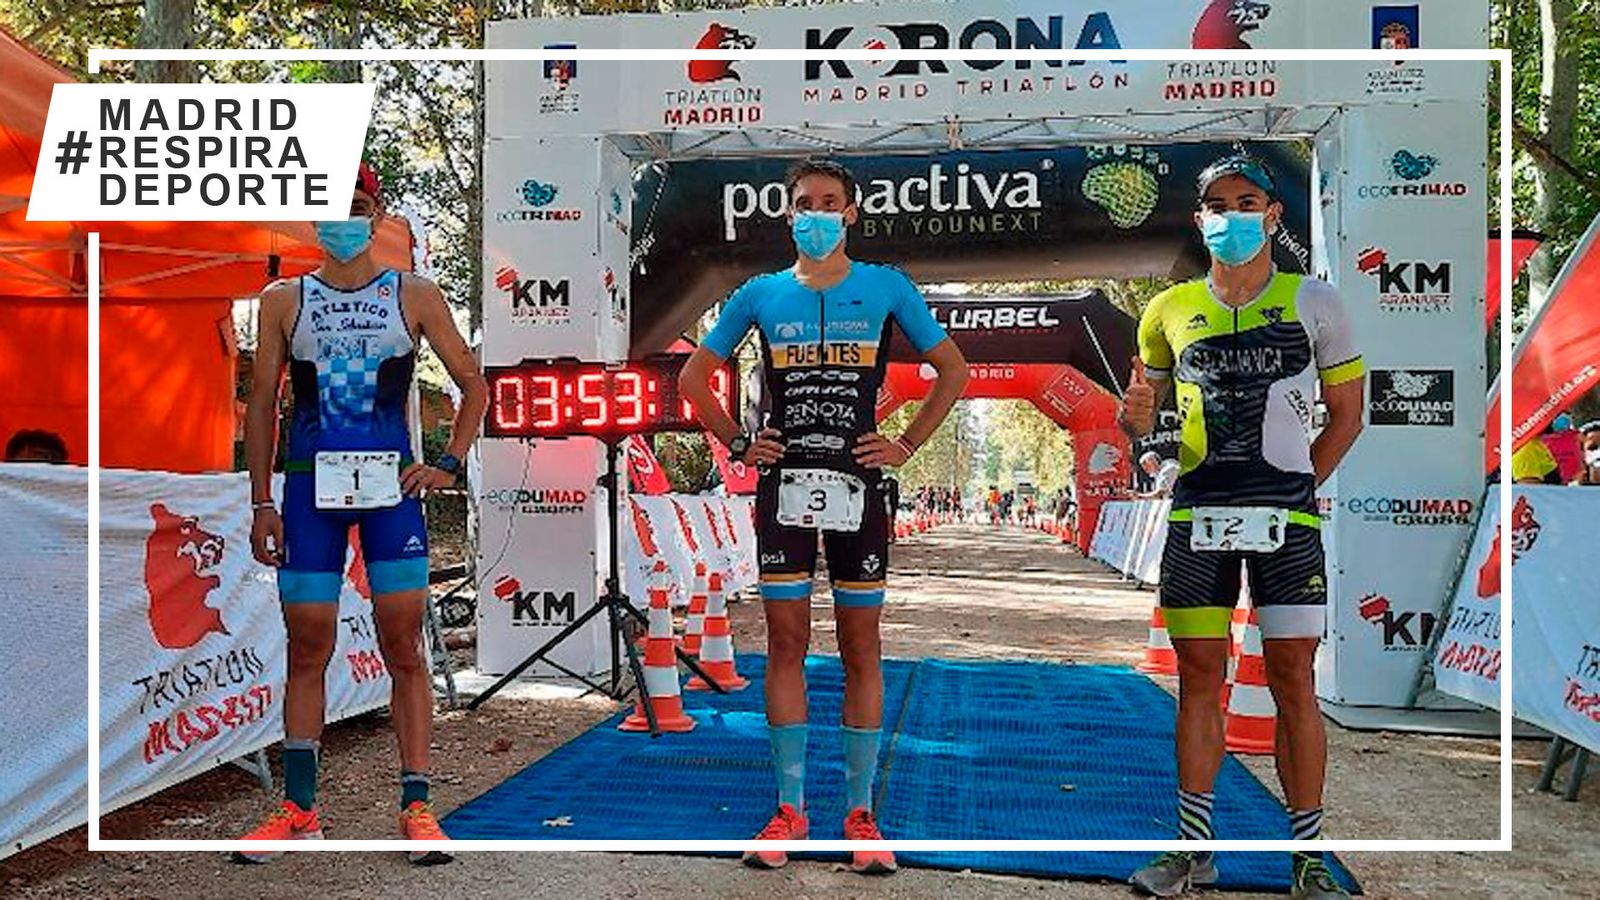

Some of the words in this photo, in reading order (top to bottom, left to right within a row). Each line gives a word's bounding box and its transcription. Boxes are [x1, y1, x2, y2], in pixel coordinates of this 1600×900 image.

[664, 88, 762, 105] TRIATLON
[804, 83, 929, 102] MADRID
[957, 73, 1128, 95] TRIATLÓN
[1165, 79, 1275, 100] MADRID
[664, 107, 762, 126] MADRID
[864, 218, 896, 238] BY
[911, 211, 1043, 236] YOUNEXT
[1380, 263, 1450, 294] KM
[512, 279, 570, 308] KM
[786, 343, 861, 364] FUENTES
[352, 469, 360, 491] 1
[807, 489, 827, 512] 3
[1348, 498, 1473, 514] ecoDUMAD
[1224, 516, 1244, 536] 2
[512, 591, 575, 621] KM
[132, 648, 265, 715] TRIATLON
